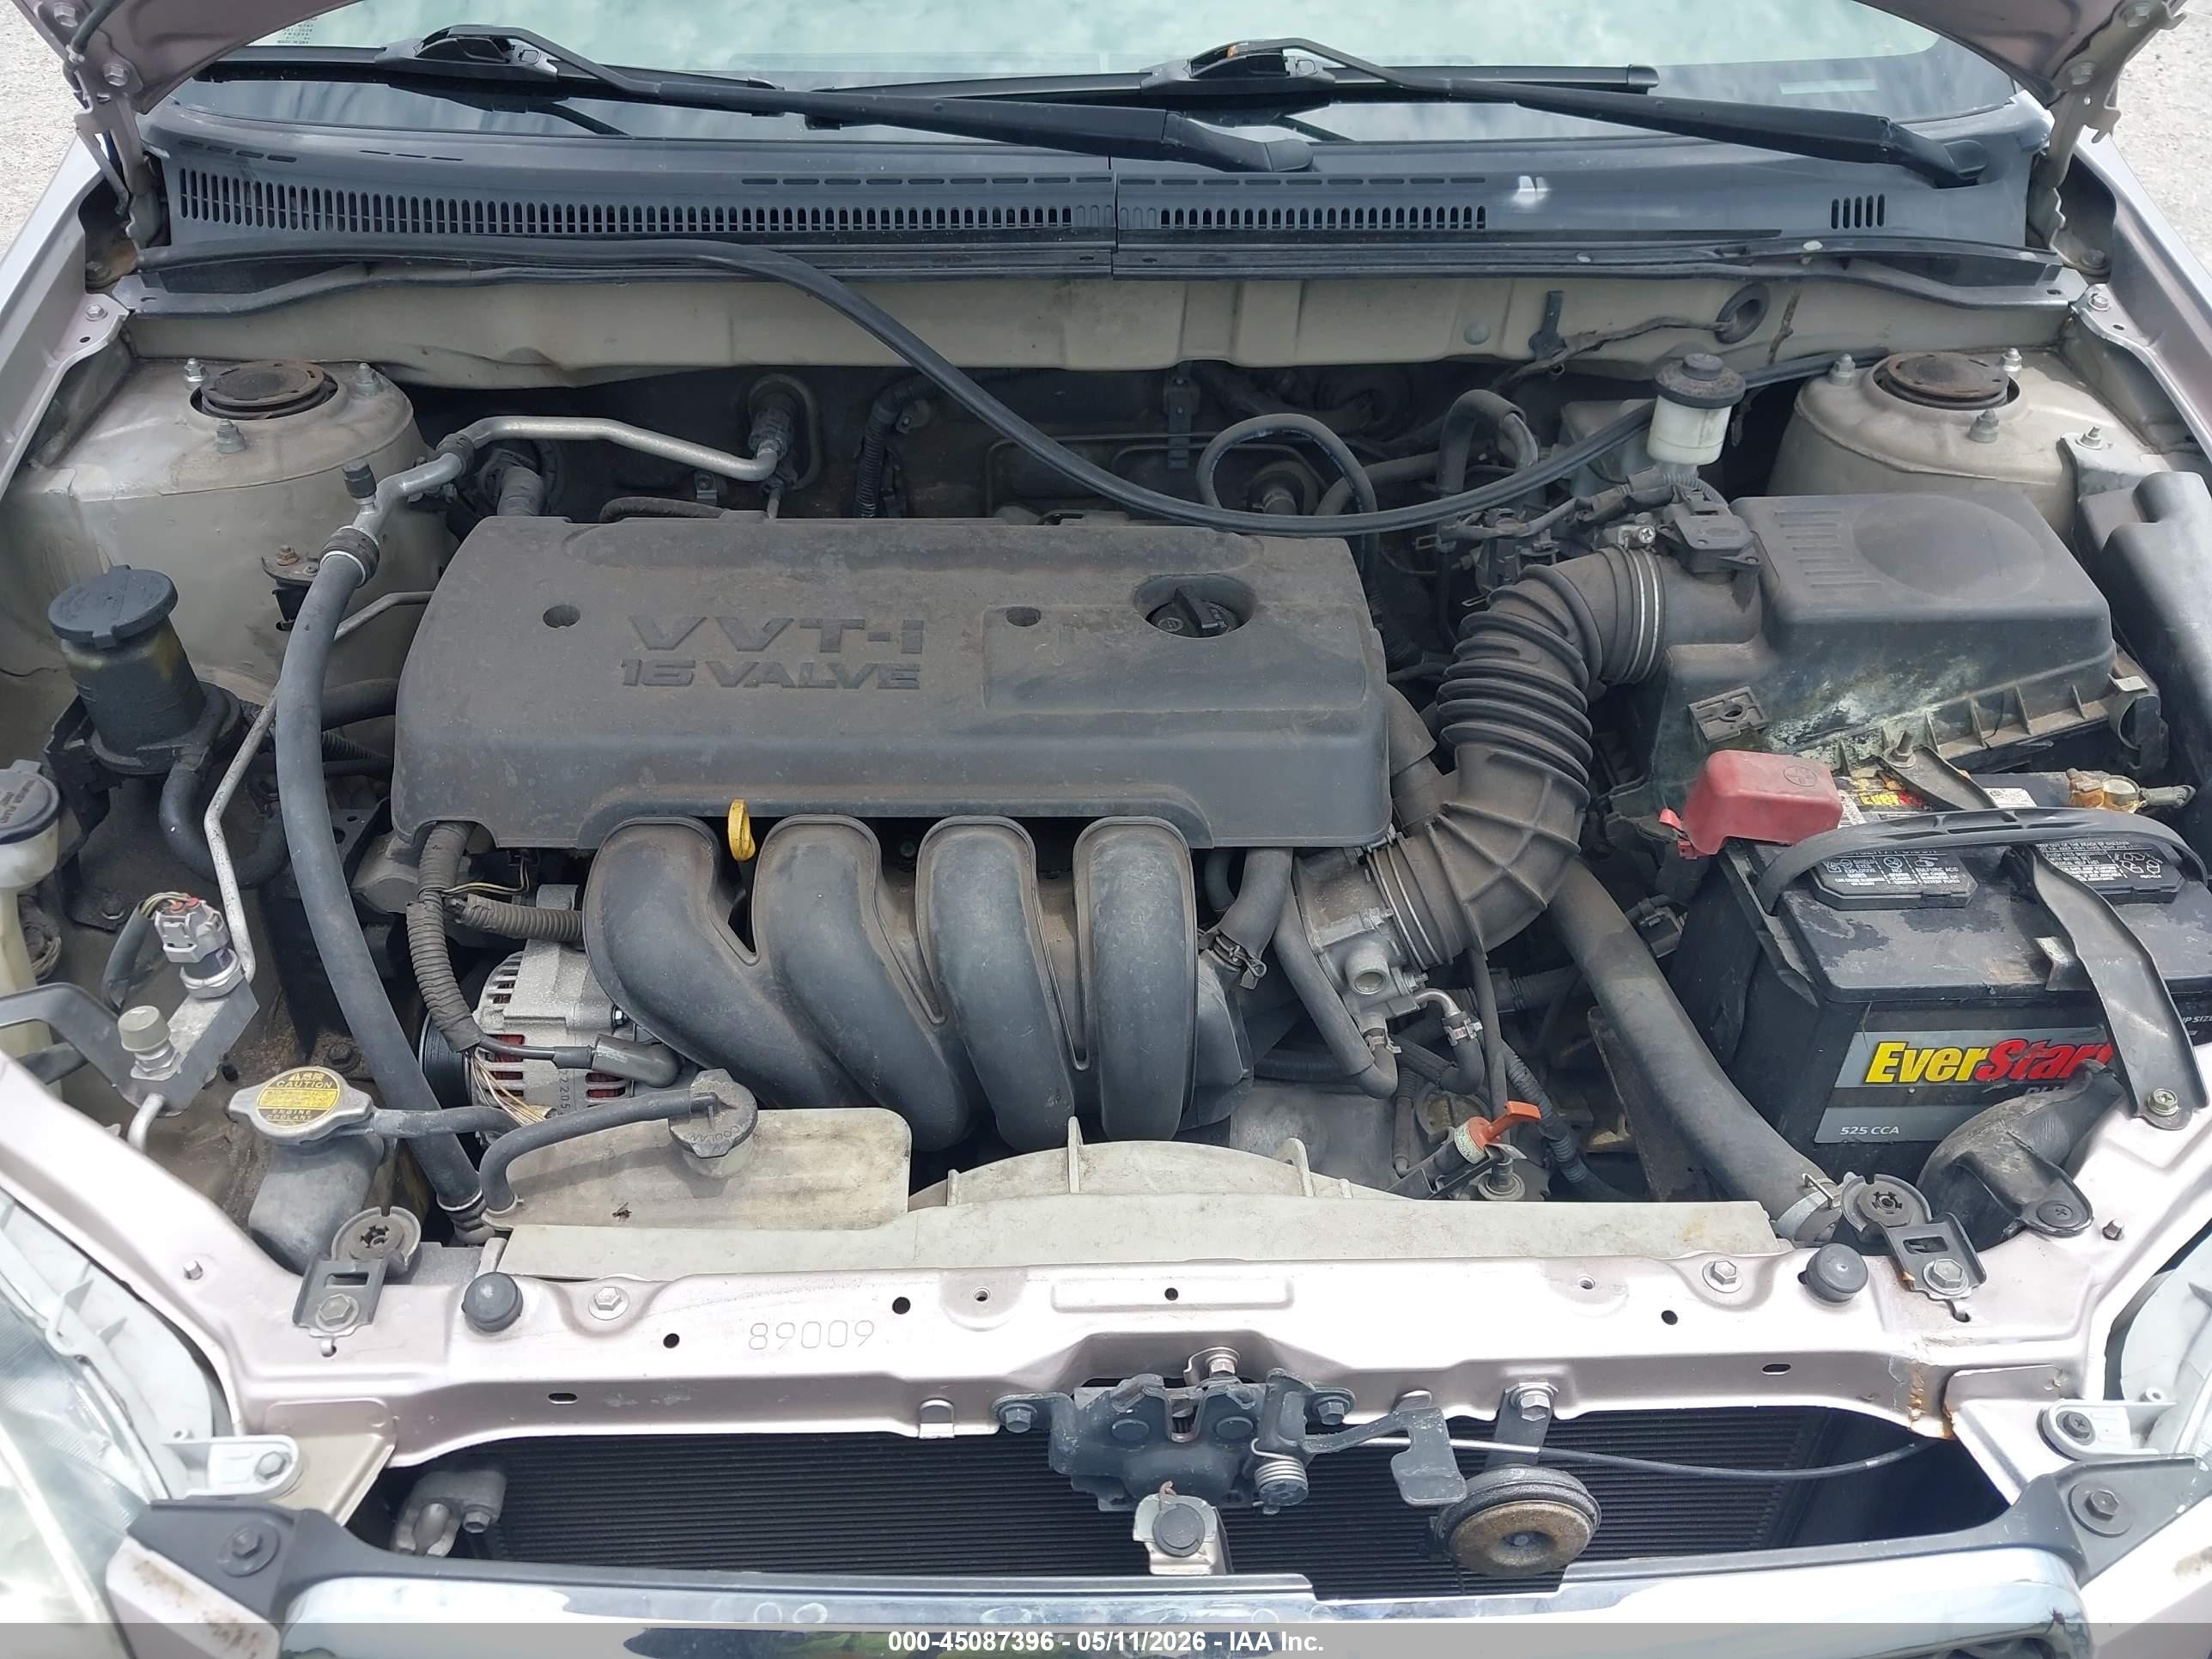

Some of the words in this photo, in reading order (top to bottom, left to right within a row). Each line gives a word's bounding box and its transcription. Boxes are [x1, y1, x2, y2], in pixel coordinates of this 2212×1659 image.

[621, 659, 696, 687] 16
[705, 660, 921, 690] VALVE
[1864, 1037, 2115, 1083] EverStar
[276, 1080, 333, 1089] CAUTION
[1840, 1126, 1869, 1135] 525
[1870, 1126, 1899, 1134] CCA
[748, 1320, 875, 1351] 89009
